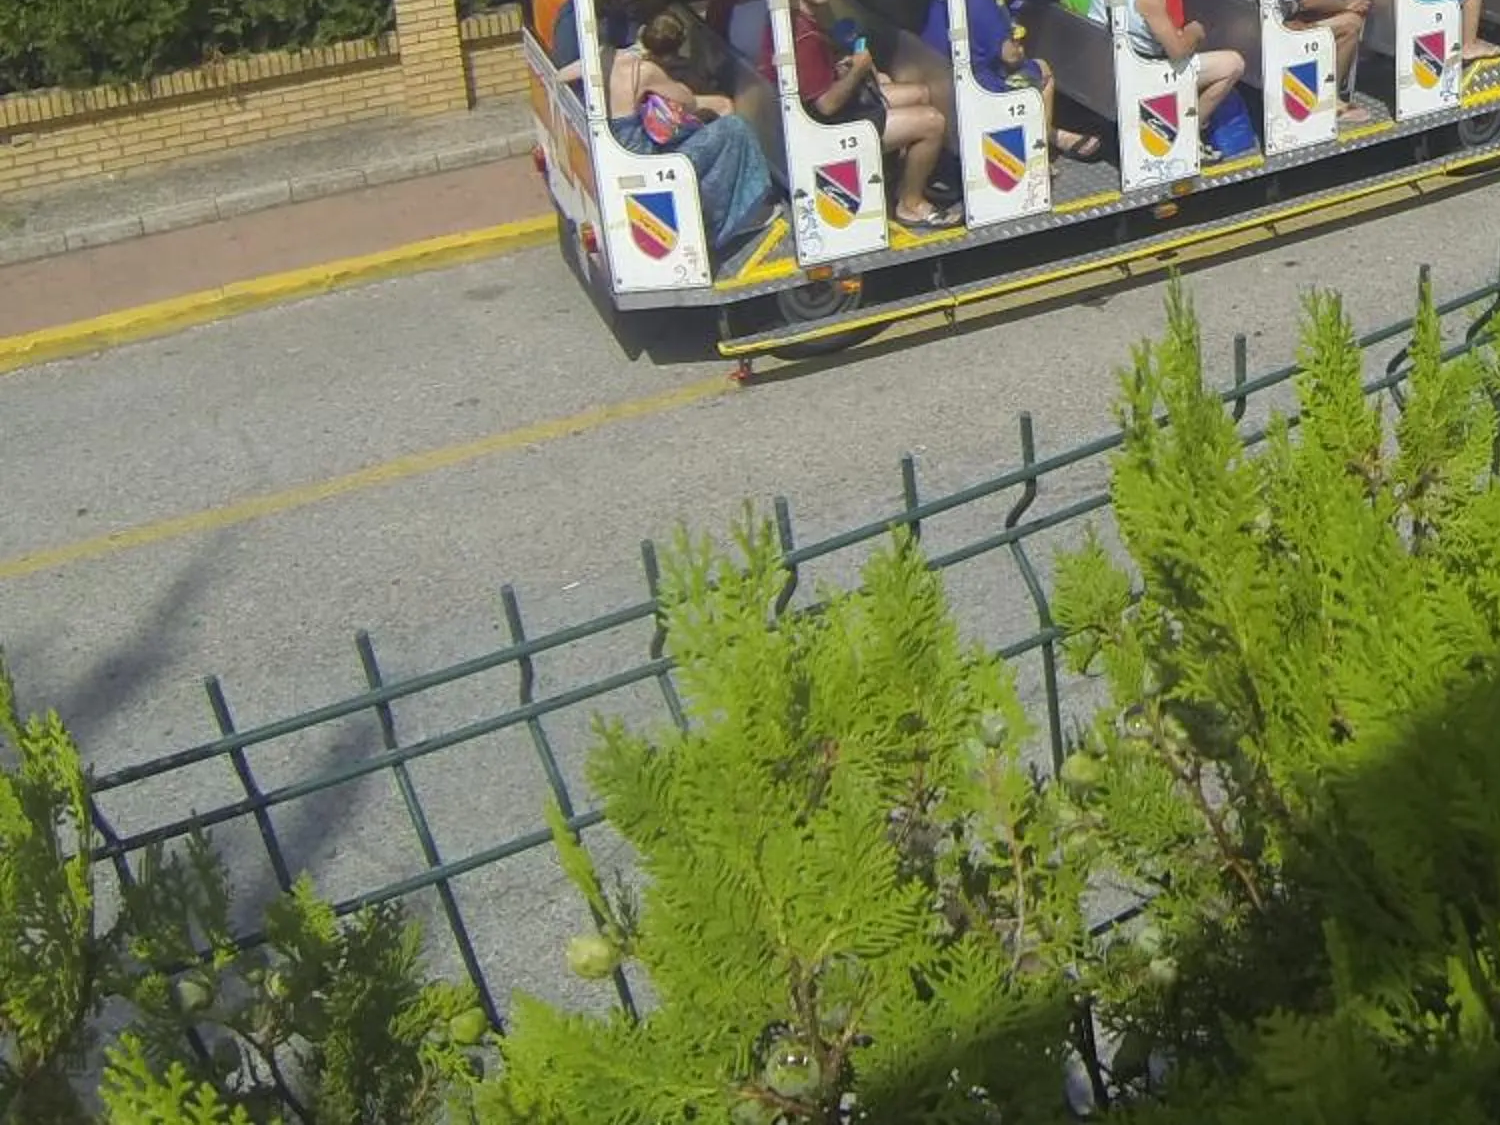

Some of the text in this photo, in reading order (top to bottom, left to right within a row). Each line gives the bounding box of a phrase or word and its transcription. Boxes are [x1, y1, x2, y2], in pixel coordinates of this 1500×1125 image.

[1304, 41, 1319, 54] 10
[1008, 103, 1026, 117] 12
[839, 136, 858, 150] 13
[656, 169, 676, 182] 14
